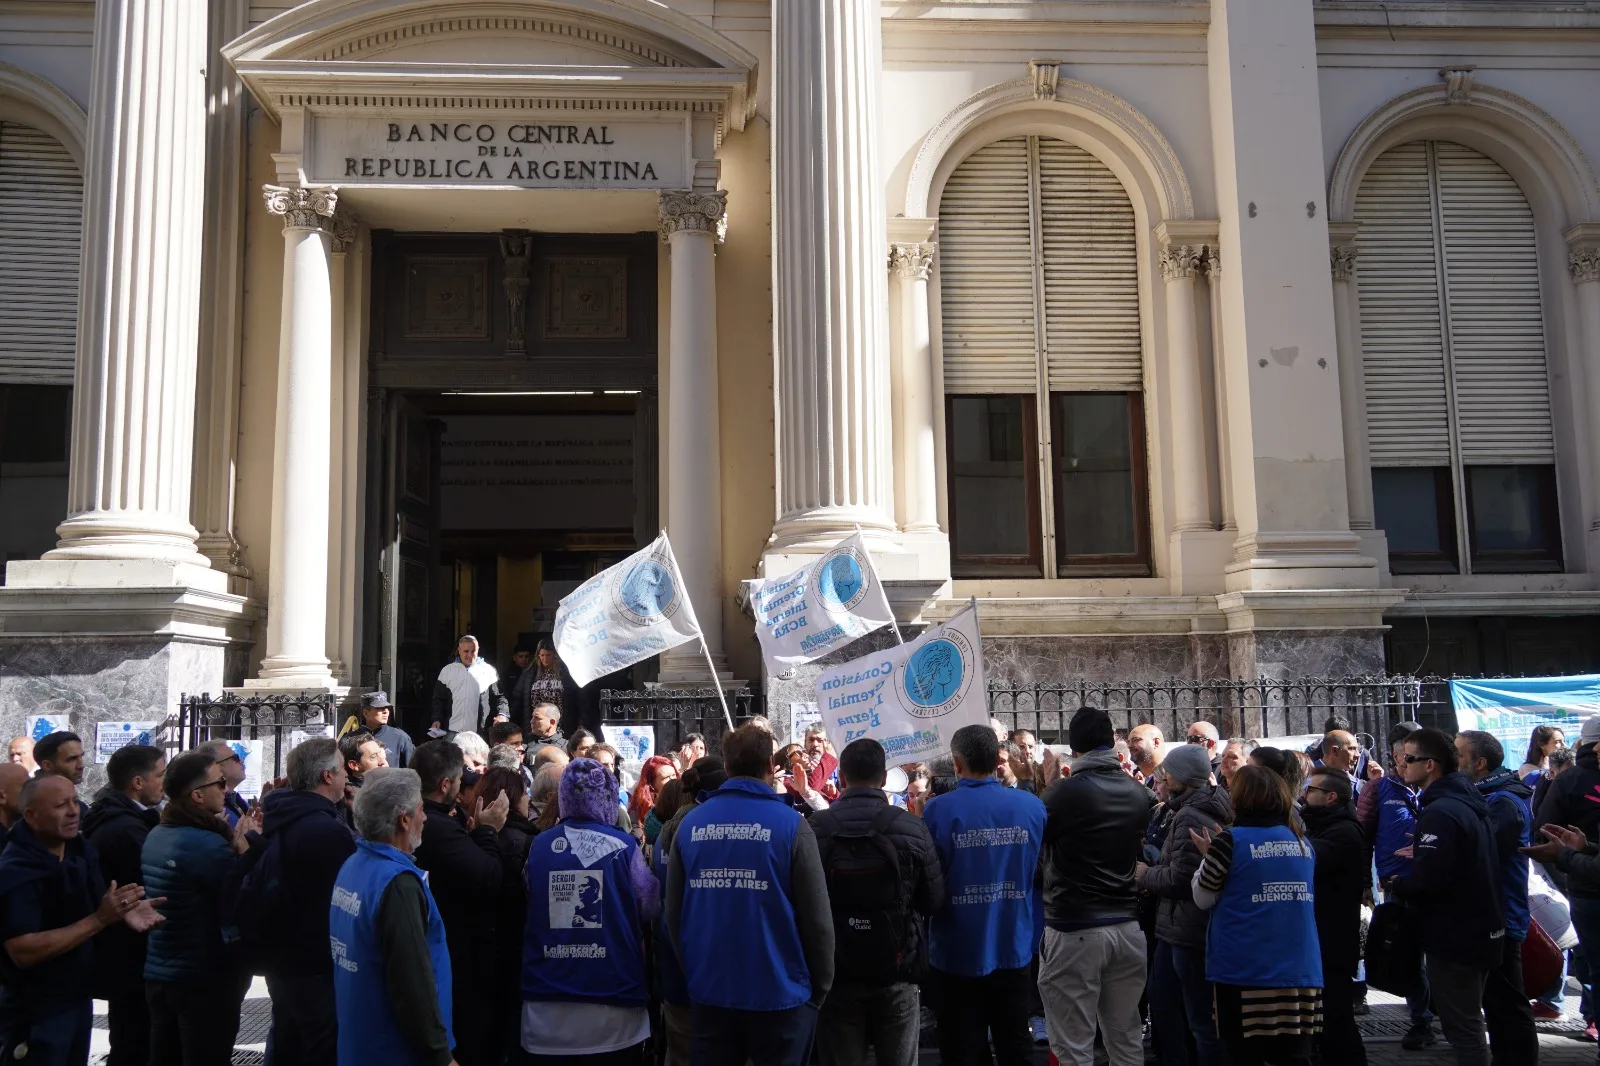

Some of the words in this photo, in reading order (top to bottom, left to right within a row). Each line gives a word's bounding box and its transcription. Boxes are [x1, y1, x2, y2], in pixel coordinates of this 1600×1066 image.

[387, 123, 495, 143] BANCO
[507, 124, 614, 145] CENTRAL
[478, 145, 499, 157] DE
[503, 146, 523, 158] LA
[344, 157, 493, 179] REPUBLICA
[507, 160, 659, 181] ARGENTINA
[727, 834, 771, 842] SINDICATO
[551, 873, 576, 884] SERGIO
[699, 868, 757, 879] seccional
[551, 883, 576, 892] PALAZZO
[690, 878, 732, 889] BUENOS
[734, 879, 769, 891] AIRES
[1262, 882, 1308, 894] seccional
[1251, 893, 1294, 903] BUENOS
